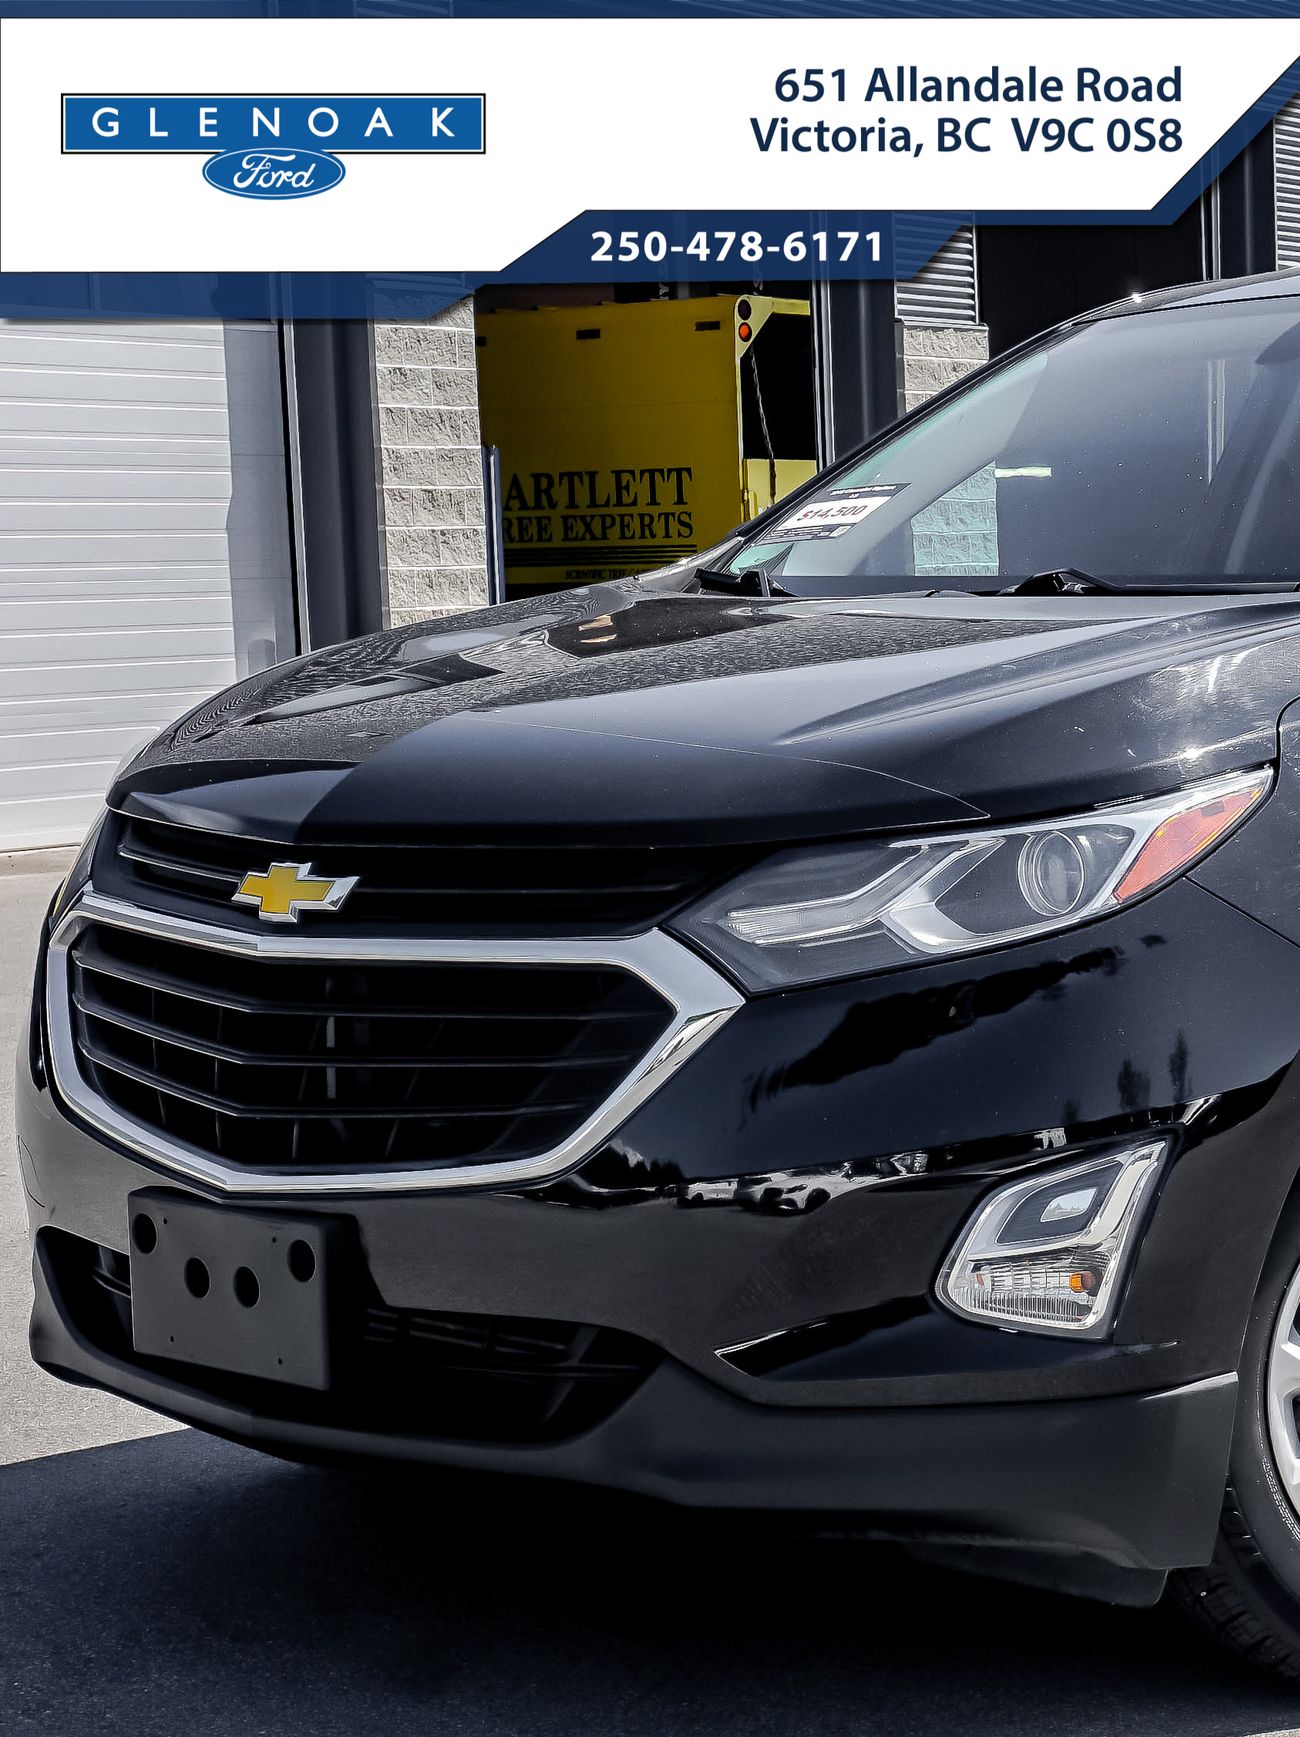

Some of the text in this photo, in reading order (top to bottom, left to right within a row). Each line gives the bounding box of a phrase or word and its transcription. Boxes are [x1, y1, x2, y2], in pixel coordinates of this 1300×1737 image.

[503, 467, 693, 512] ARTLETT
[503, 511, 694, 544] REE EXPERTS
[797, 504, 869, 522] $14,500
